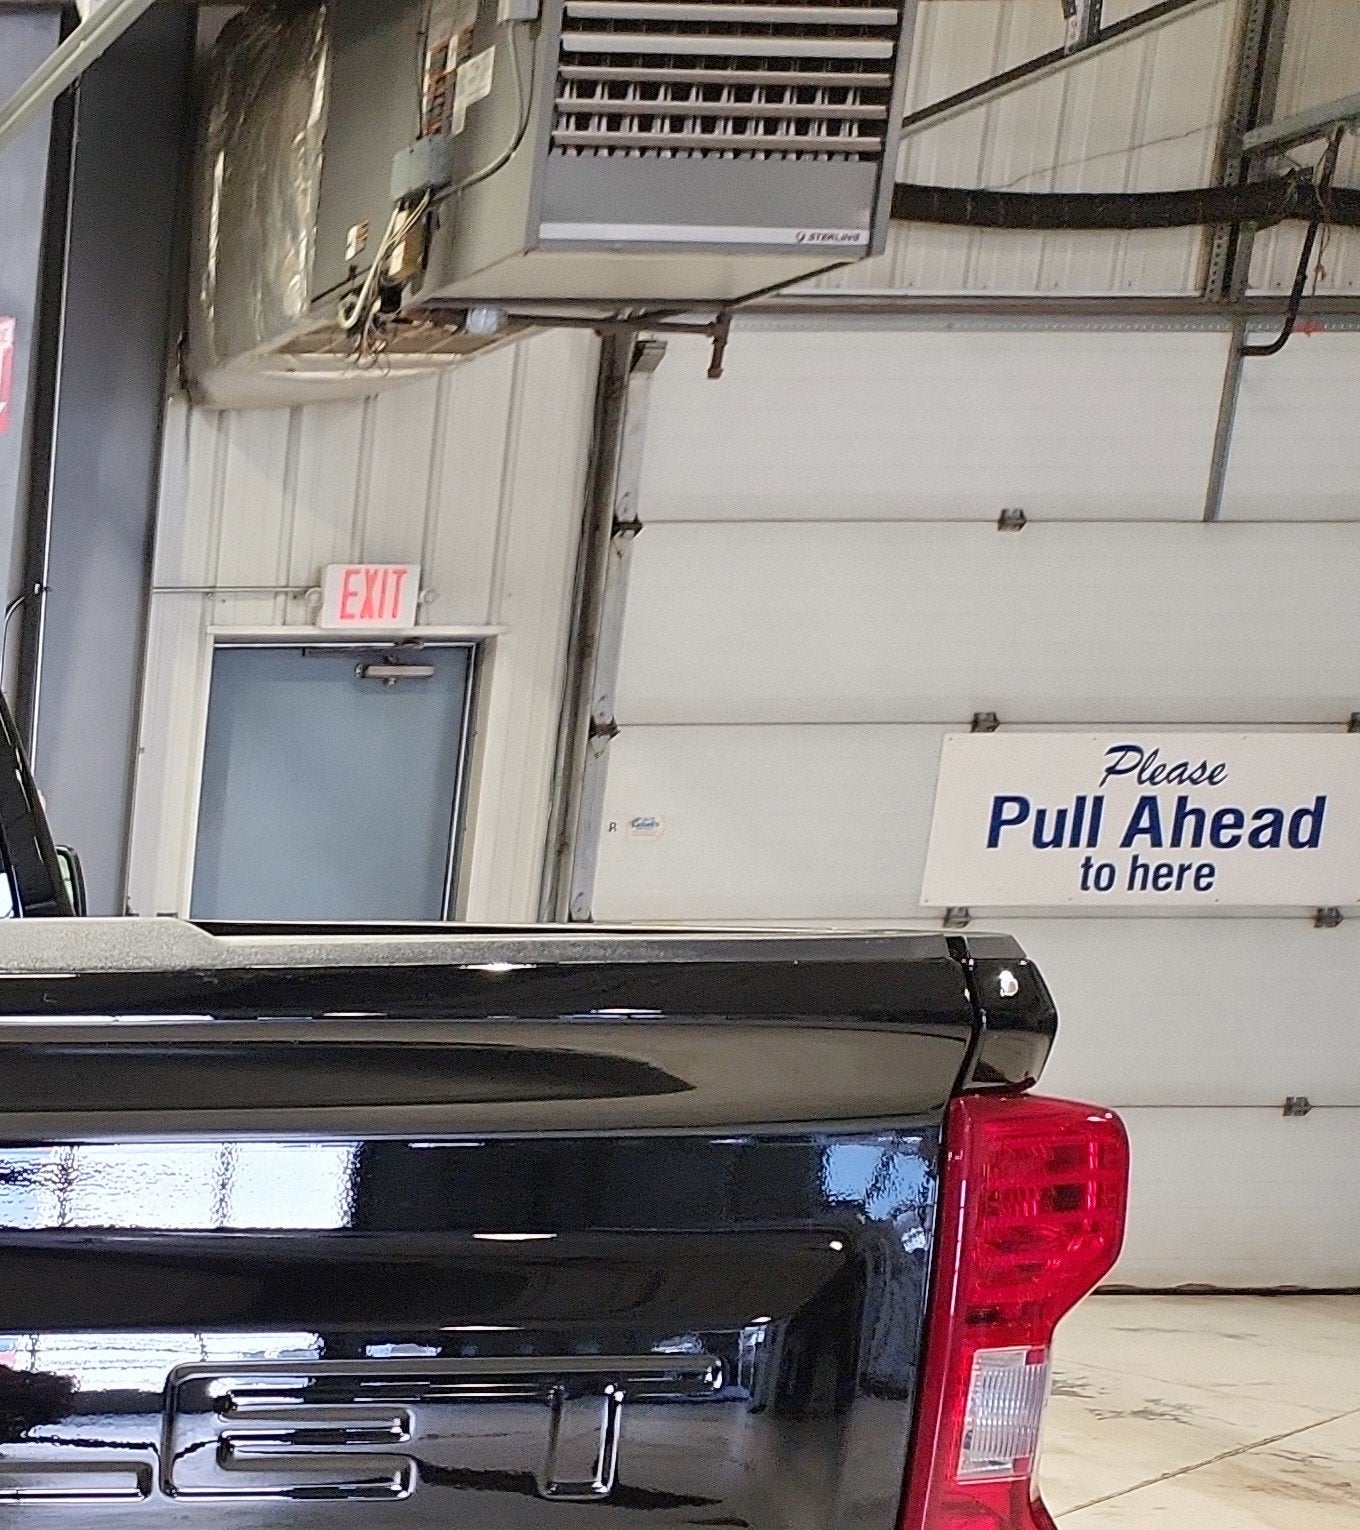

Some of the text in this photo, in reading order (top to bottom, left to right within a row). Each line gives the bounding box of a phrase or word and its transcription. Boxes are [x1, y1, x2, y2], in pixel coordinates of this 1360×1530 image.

[340, 567, 408, 620] EXIT
[1099, 744, 1229, 787] Please
[986, 794, 1328, 850] Pull Ahead
[1080, 854, 1216, 891] to here
